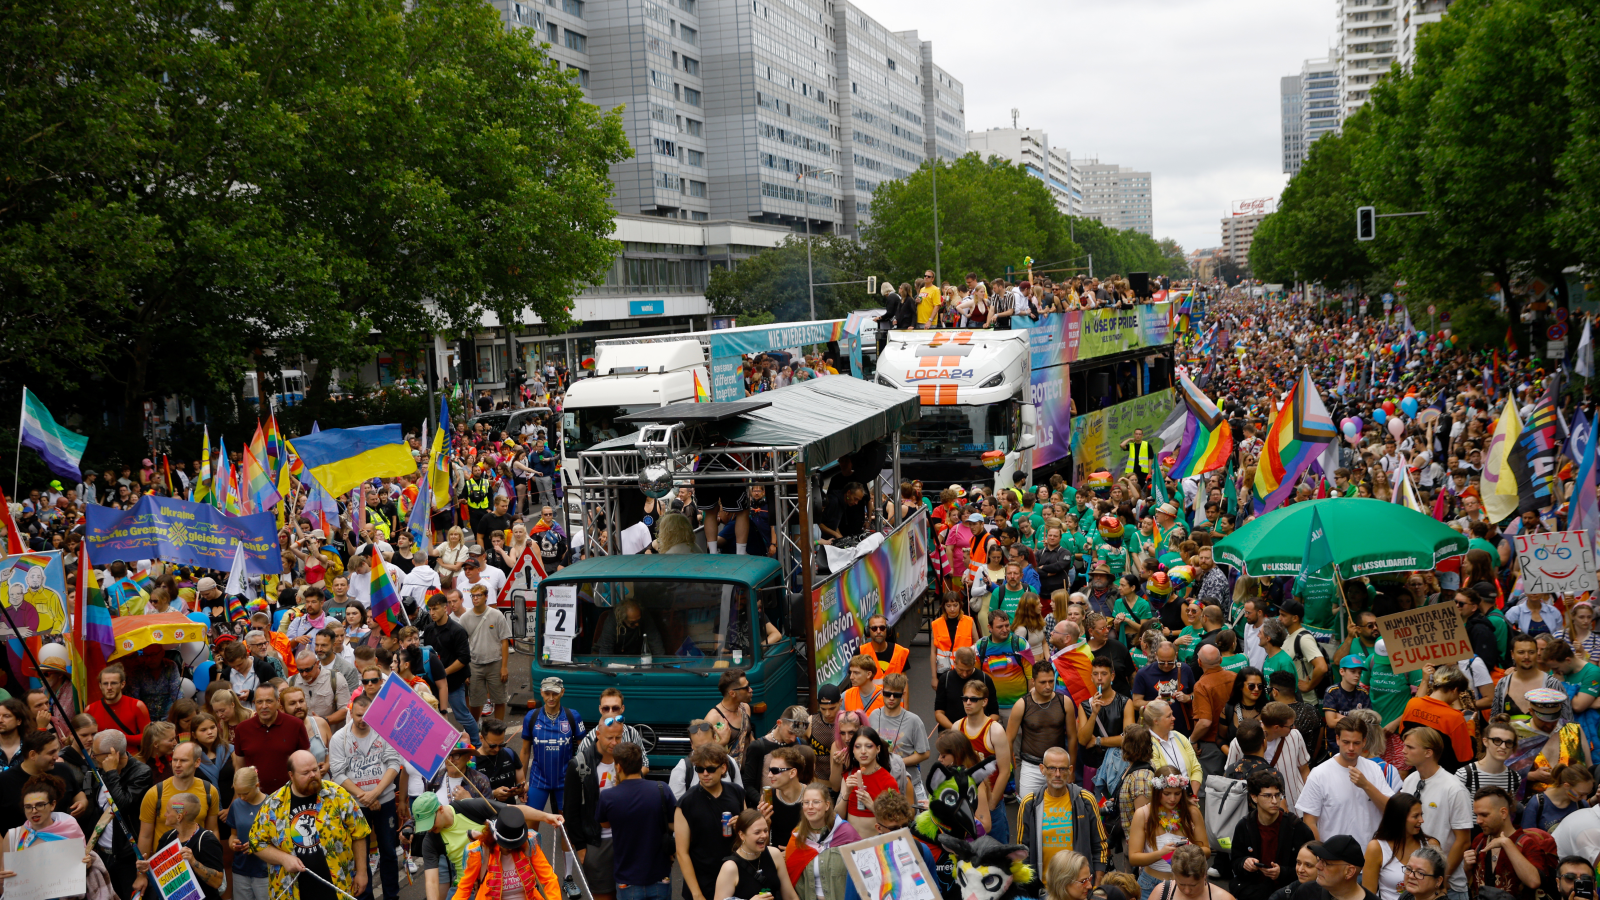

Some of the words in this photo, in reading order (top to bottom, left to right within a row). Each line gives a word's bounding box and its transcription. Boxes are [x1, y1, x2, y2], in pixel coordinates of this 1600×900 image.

[1108, 317, 1117, 331] OF
[1118, 315, 1138, 330] PRIDE
[768, 330, 781, 348] NIE
[780, 327, 807, 347] WIEDER
[715, 373, 737, 387] different
[716, 387, 738, 401] together
[999, 441, 1005, 451] 4
[160, 506, 195, 520] Ukraine
[188, 531, 226, 545] gleiche
[230, 536, 270, 551] Rchte
[1516, 530, 1585, 553] JETZT
[554, 608, 567, 632] 2
[1383, 606, 1457, 631] HUMANITARIAN
[1393, 626, 1413, 640] AID
[1415, 621, 1438, 635] FOR
[1438, 618, 1459, 630] THE
[815, 611, 854, 652] Inklusion
[1401, 632, 1438, 648] PEOPLE
[1442, 629, 1456, 641] OF
[1392, 639, 1471, 668] SUWEIDA
[816, 653, 842, 686] nicht
[160, 864, 183, 886] SONNE
[164, 873, 187, 894] NATUR
